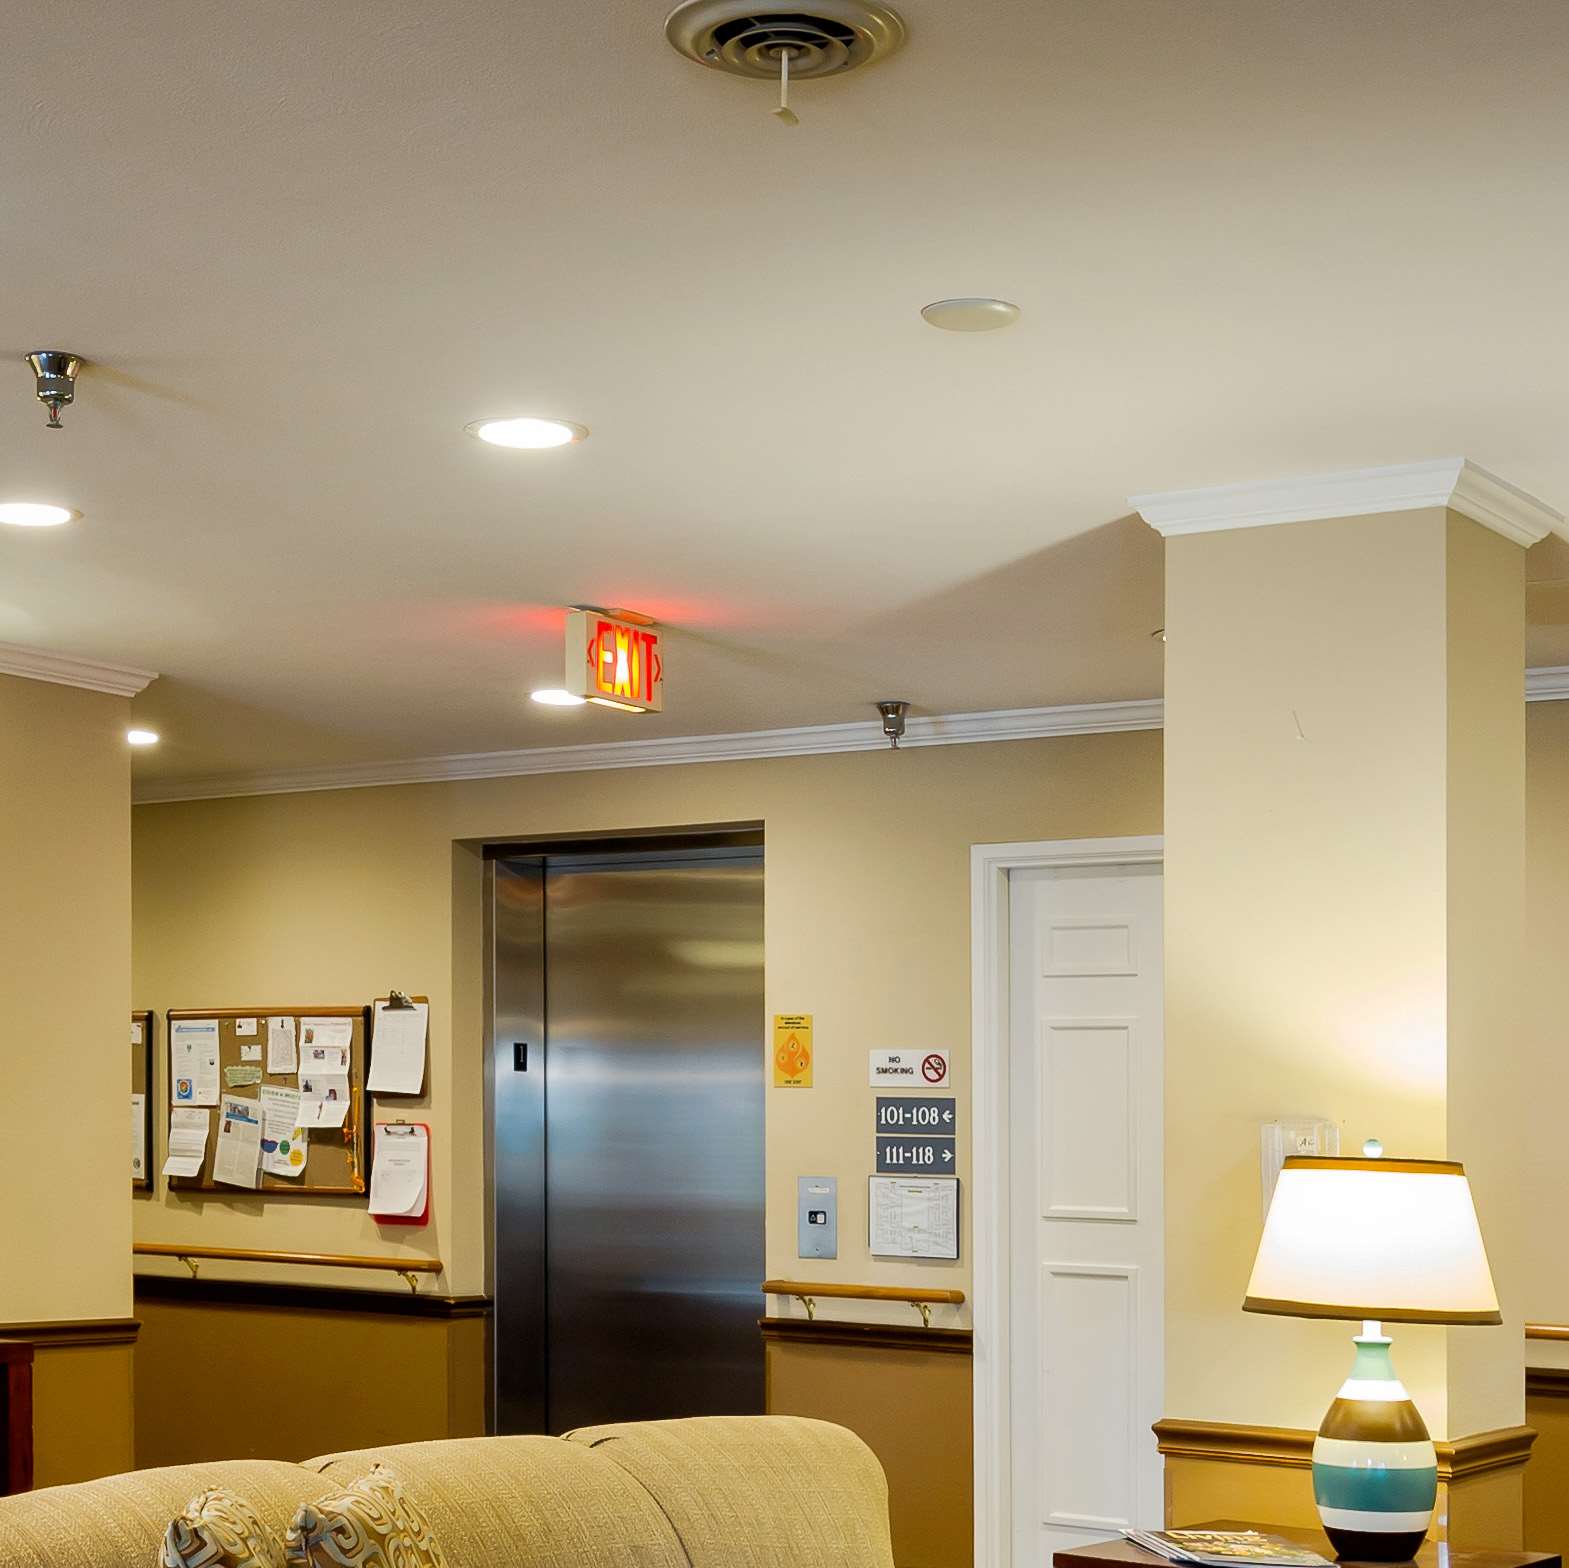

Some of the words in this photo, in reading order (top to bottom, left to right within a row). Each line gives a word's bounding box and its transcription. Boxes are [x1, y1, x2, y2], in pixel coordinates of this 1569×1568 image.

[596, 621, 658, 702] EXIT
[887, 1055, 901, 1064] NO
[875, 1066, 914, 1075] SMOKING
[879, 1106, 939, 1125] 101-108
[884, 1146, 934, 1165] 111-118
